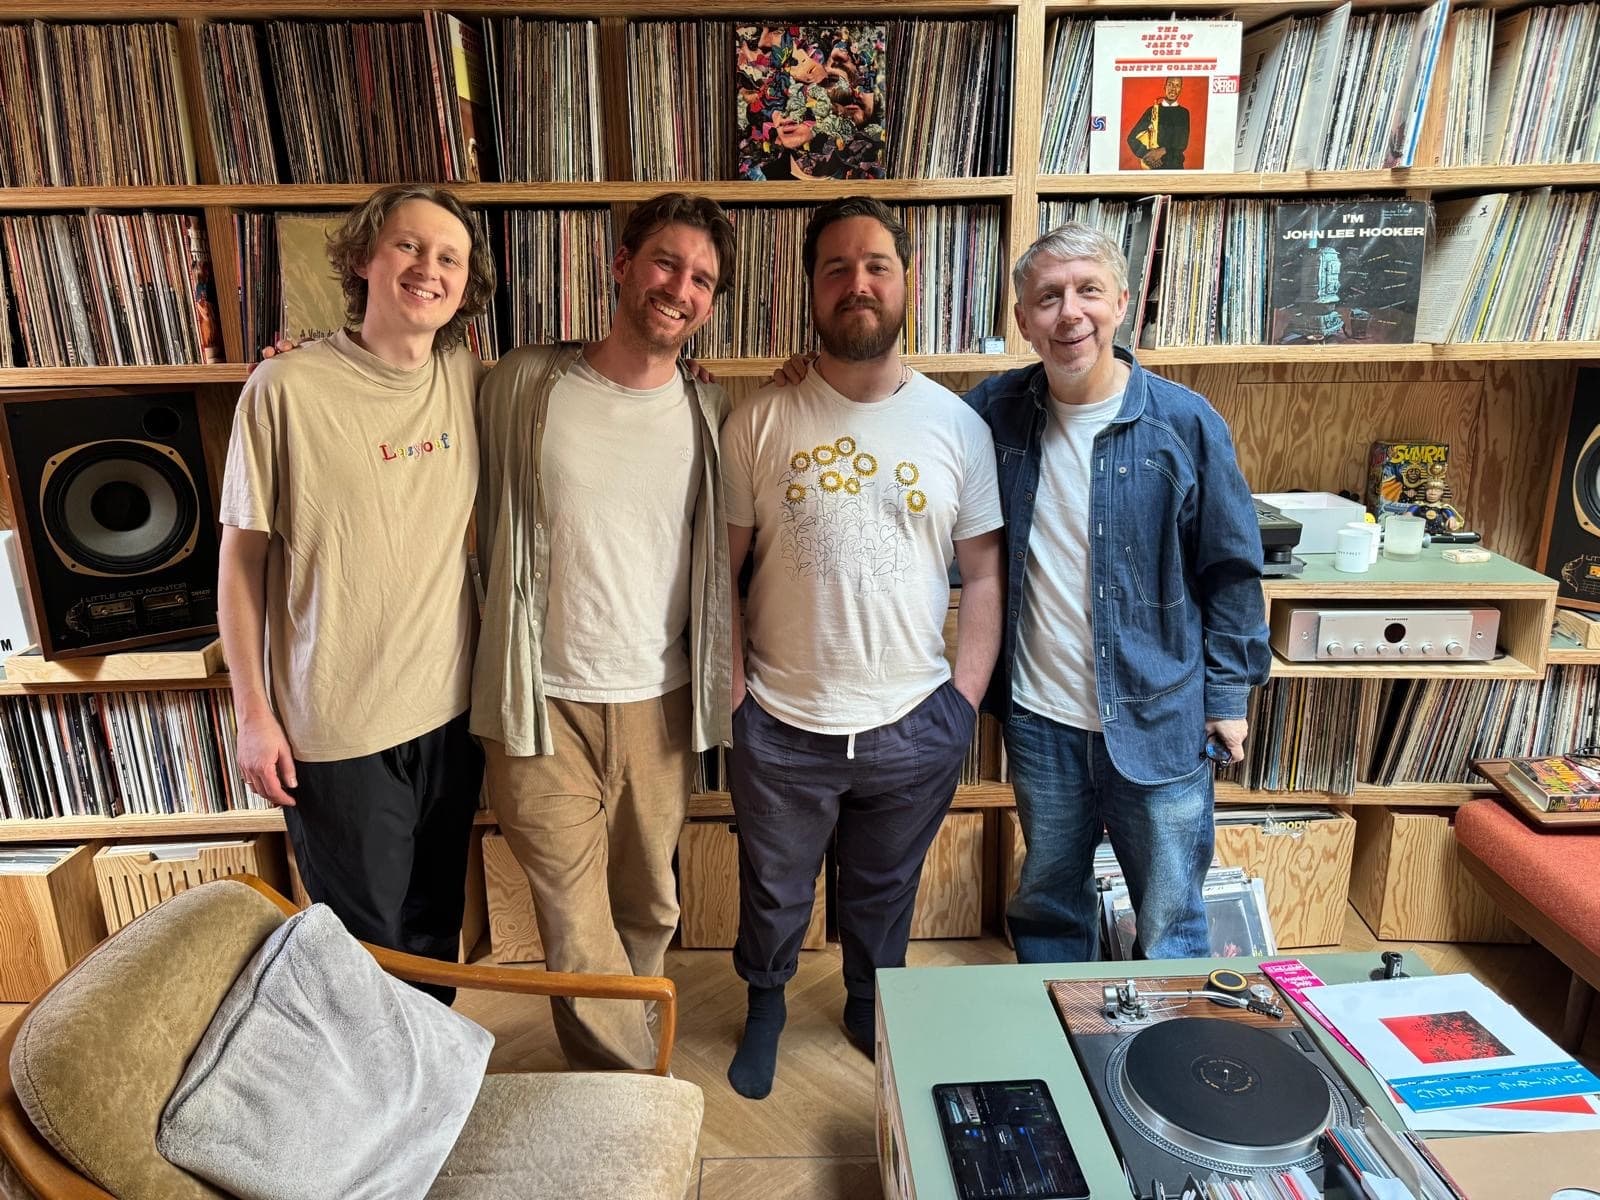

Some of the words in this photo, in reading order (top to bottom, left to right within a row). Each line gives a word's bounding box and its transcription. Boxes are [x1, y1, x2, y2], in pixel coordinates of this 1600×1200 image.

[1342, 214, 1364, 224] I'M
[1282, 230, 1325, 240] JOHN
[1327, 229, 1355, 238] LEE
[1359, 227, 1424, 237] HOOKER
[118, 589, 144, 598] GOLD
[145, 582, 187, 594] MONITOR
